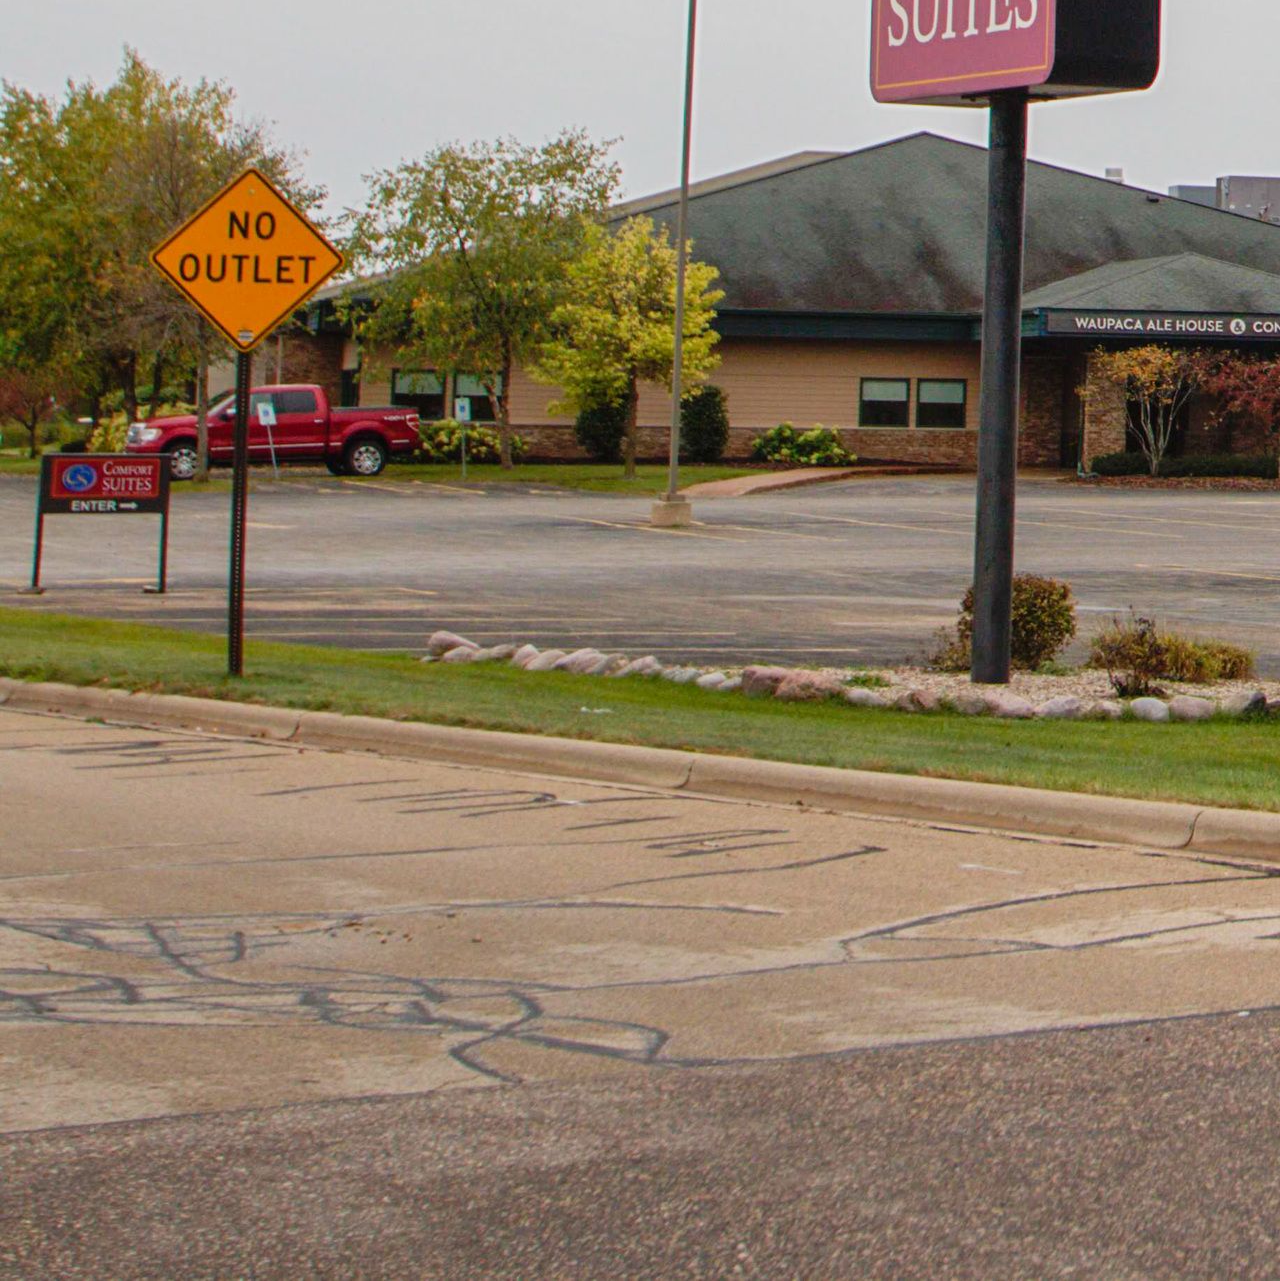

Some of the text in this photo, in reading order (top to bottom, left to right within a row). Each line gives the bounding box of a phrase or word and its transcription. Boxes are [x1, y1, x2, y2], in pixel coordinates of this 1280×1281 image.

[227, 210, 276, 240] NO
[179, 253, 316, 284] OUTLET
[1075, 317, 1143, 330] WAUPACA
[1146, 319, 1173, 331] ALE
[1176, 319, 1224, 332] HOUSE
[102, 477, 152, 491] SUITES
[71, 500, 117, 511] ENTER
